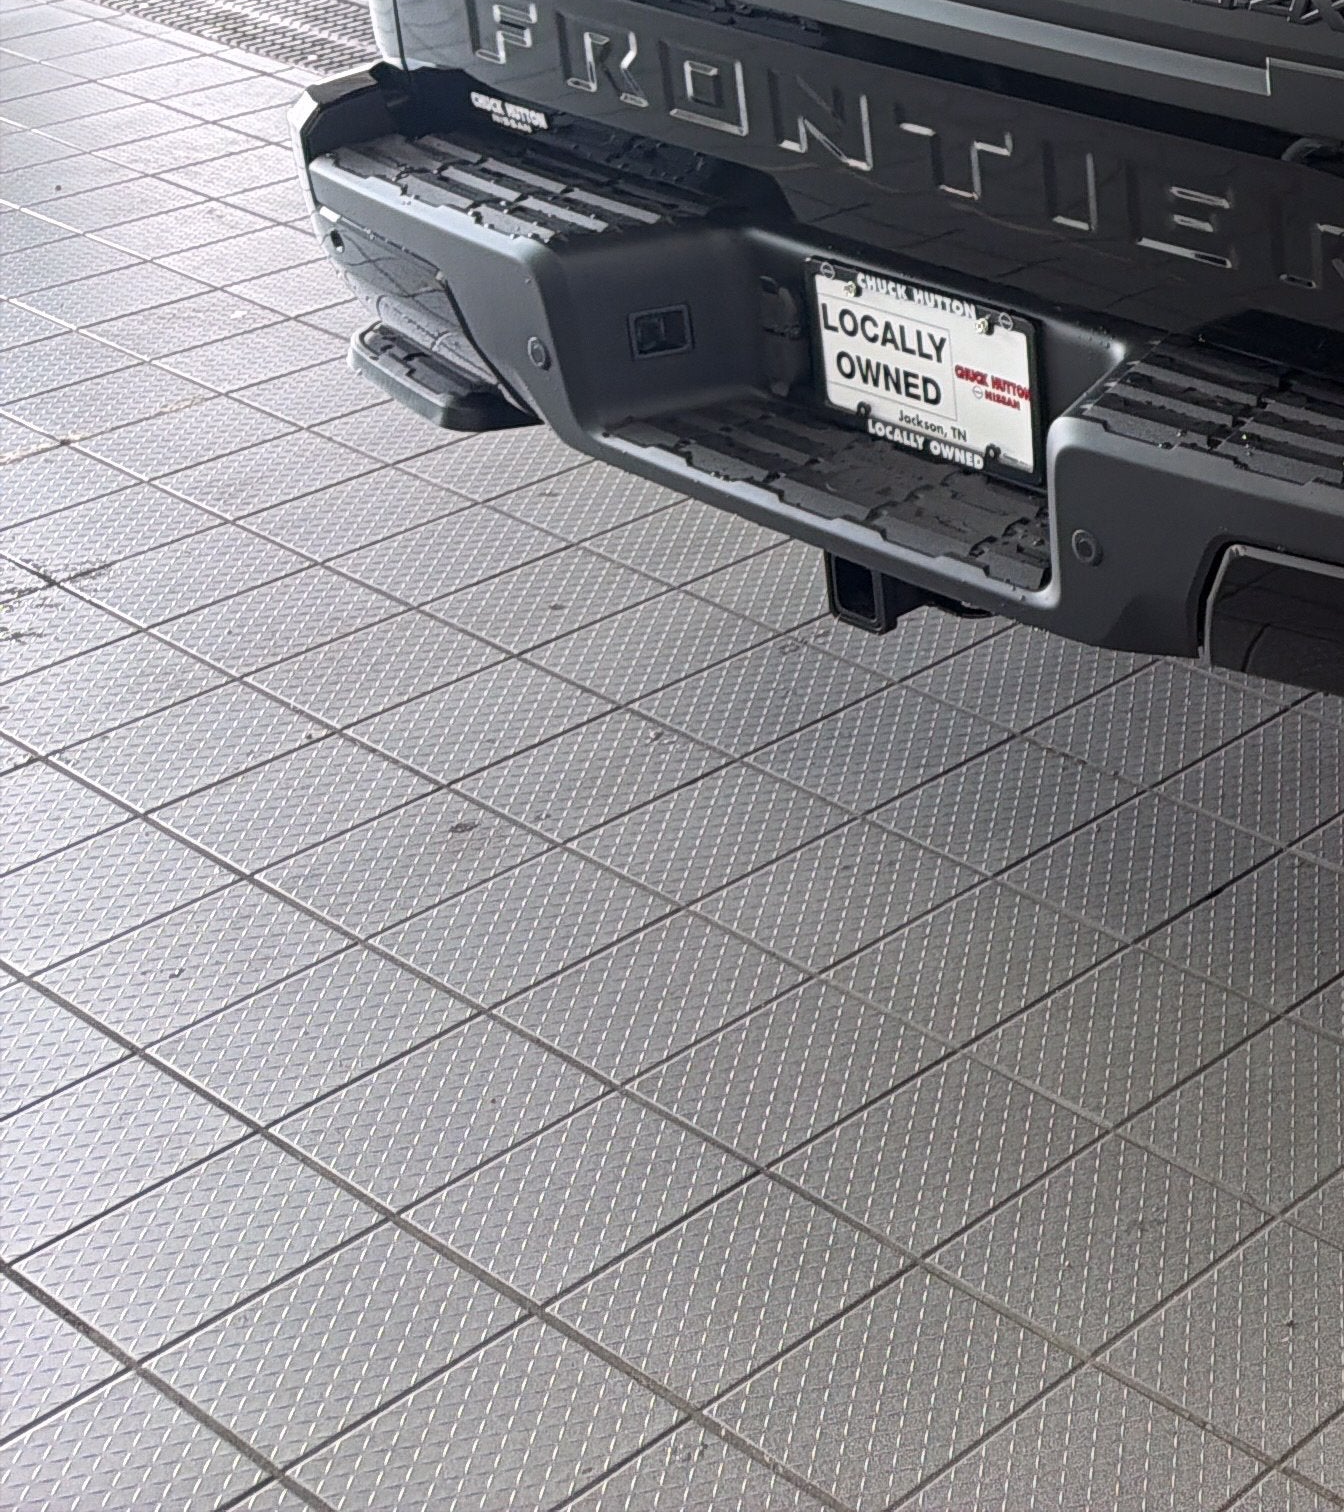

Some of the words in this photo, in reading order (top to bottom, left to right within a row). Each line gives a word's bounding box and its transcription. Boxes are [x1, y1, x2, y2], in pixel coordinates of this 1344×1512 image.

[856, 272, 909, 301] CHUCK
[913, 287, 976, 320] HUTTON
[821, 302, 947, 364] LOCALLY
[836, 350, 943, 406] OWNED
[955, 364, 989, 388] CHUCK
[991, 375, 1032, 401] HUTTON
[985, 390, 1021, 411] NISSAN
[867, 418, 925, 452] LOCALLY
[929, 437, 985, 470] OWNED
[899, 409, 949, 438] Jackson,
[951, 425, 968, 443] TN
